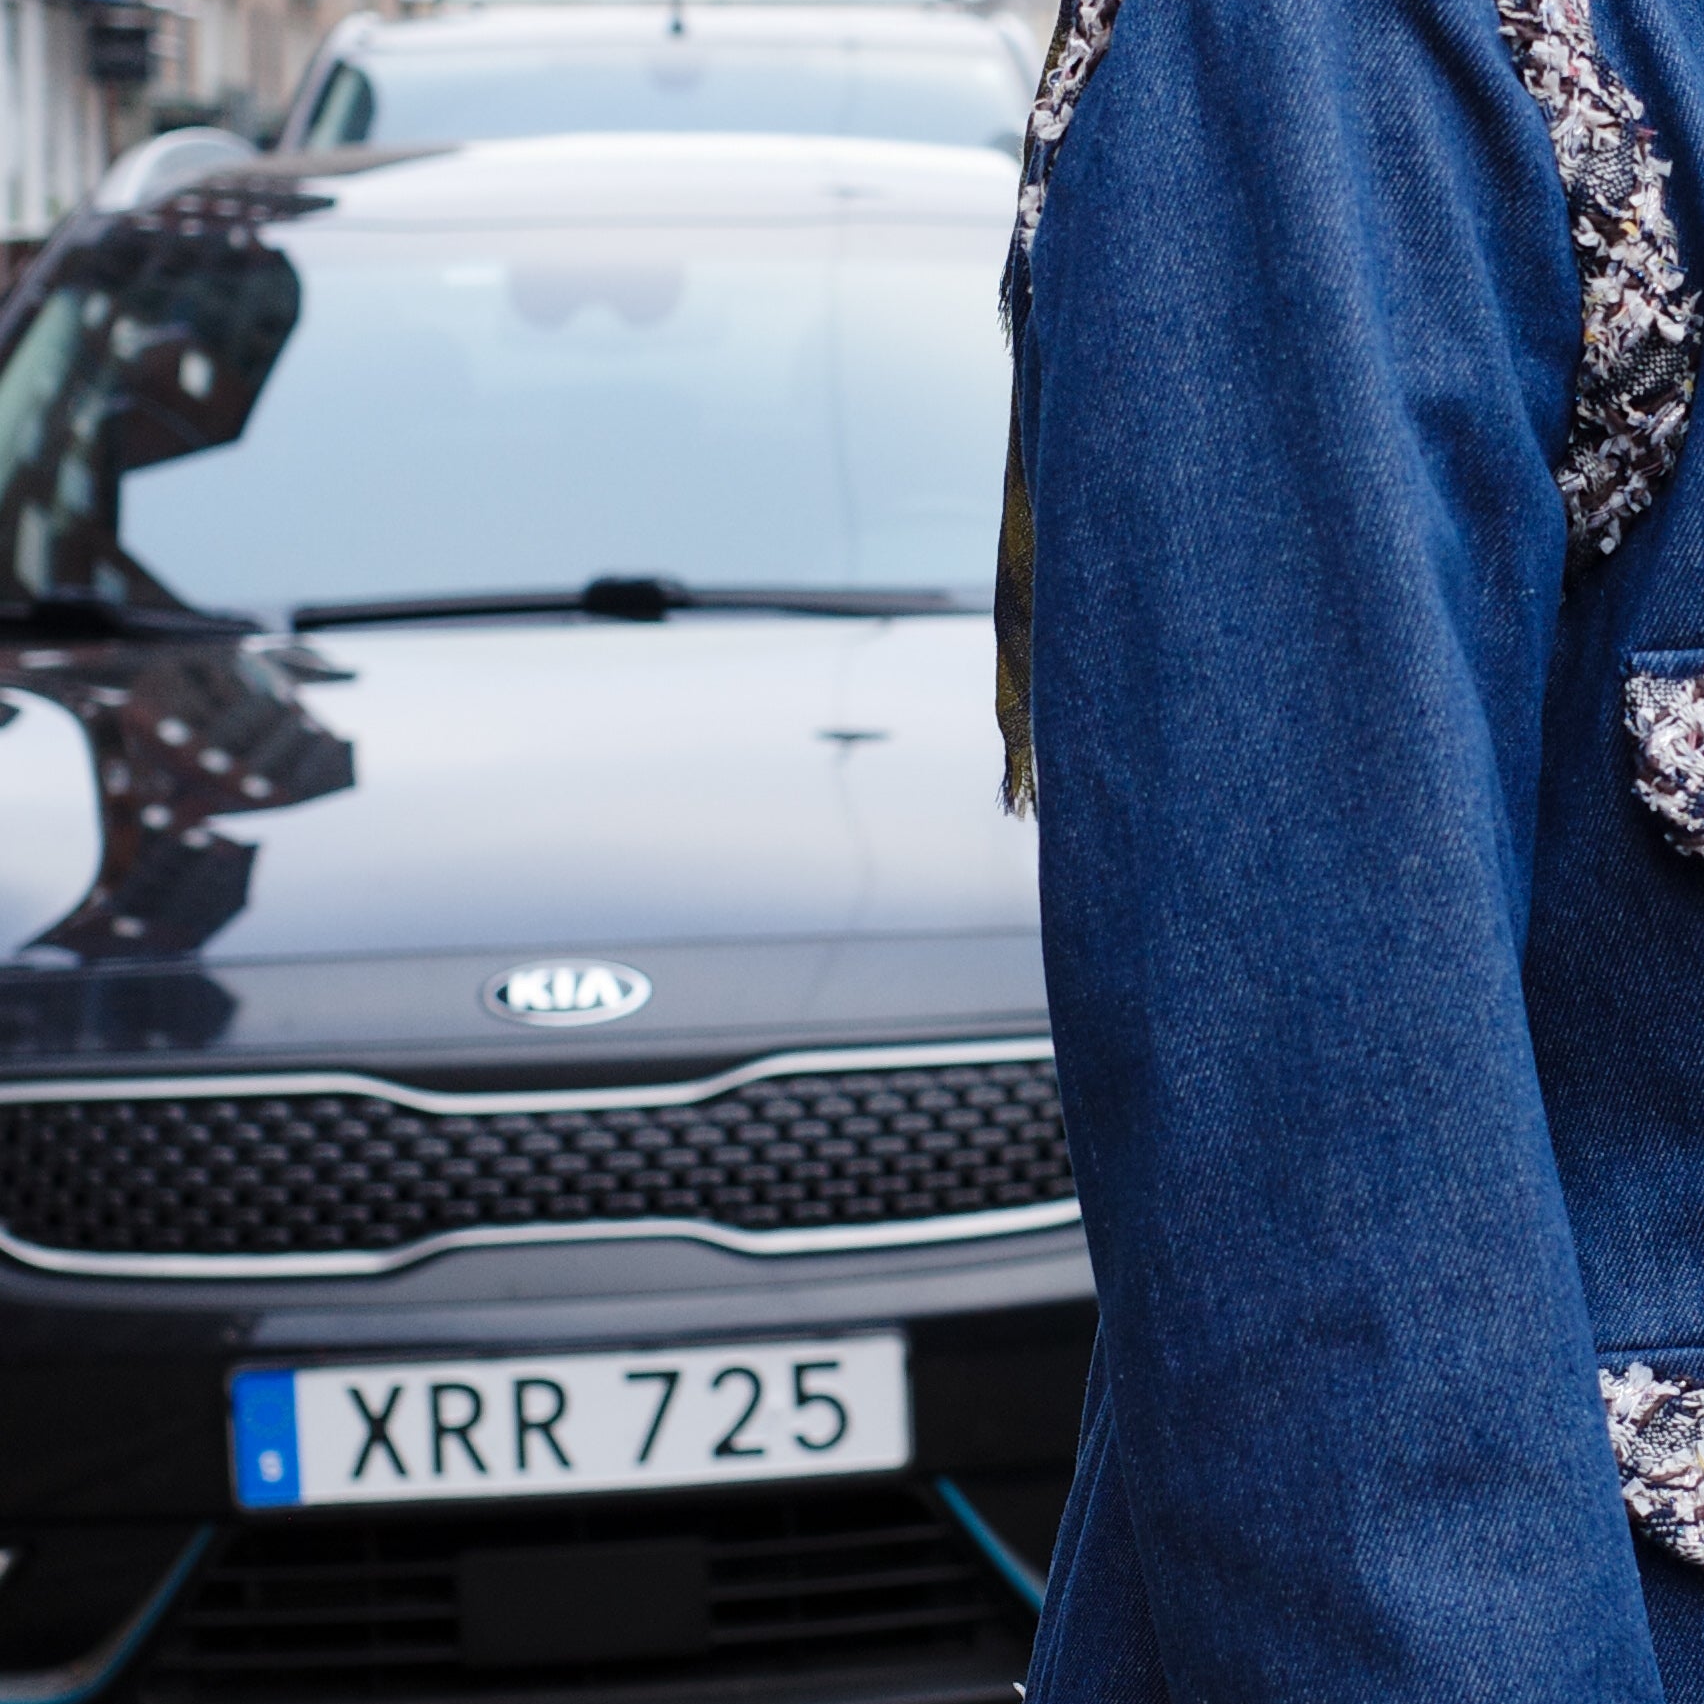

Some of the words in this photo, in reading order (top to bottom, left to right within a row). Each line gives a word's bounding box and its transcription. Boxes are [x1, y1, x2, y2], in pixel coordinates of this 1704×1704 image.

[507, 966, 623, 1012] KIA
[348, 1377, 571, 1479] XRR
[624, 1359, 849, 1463] 725
